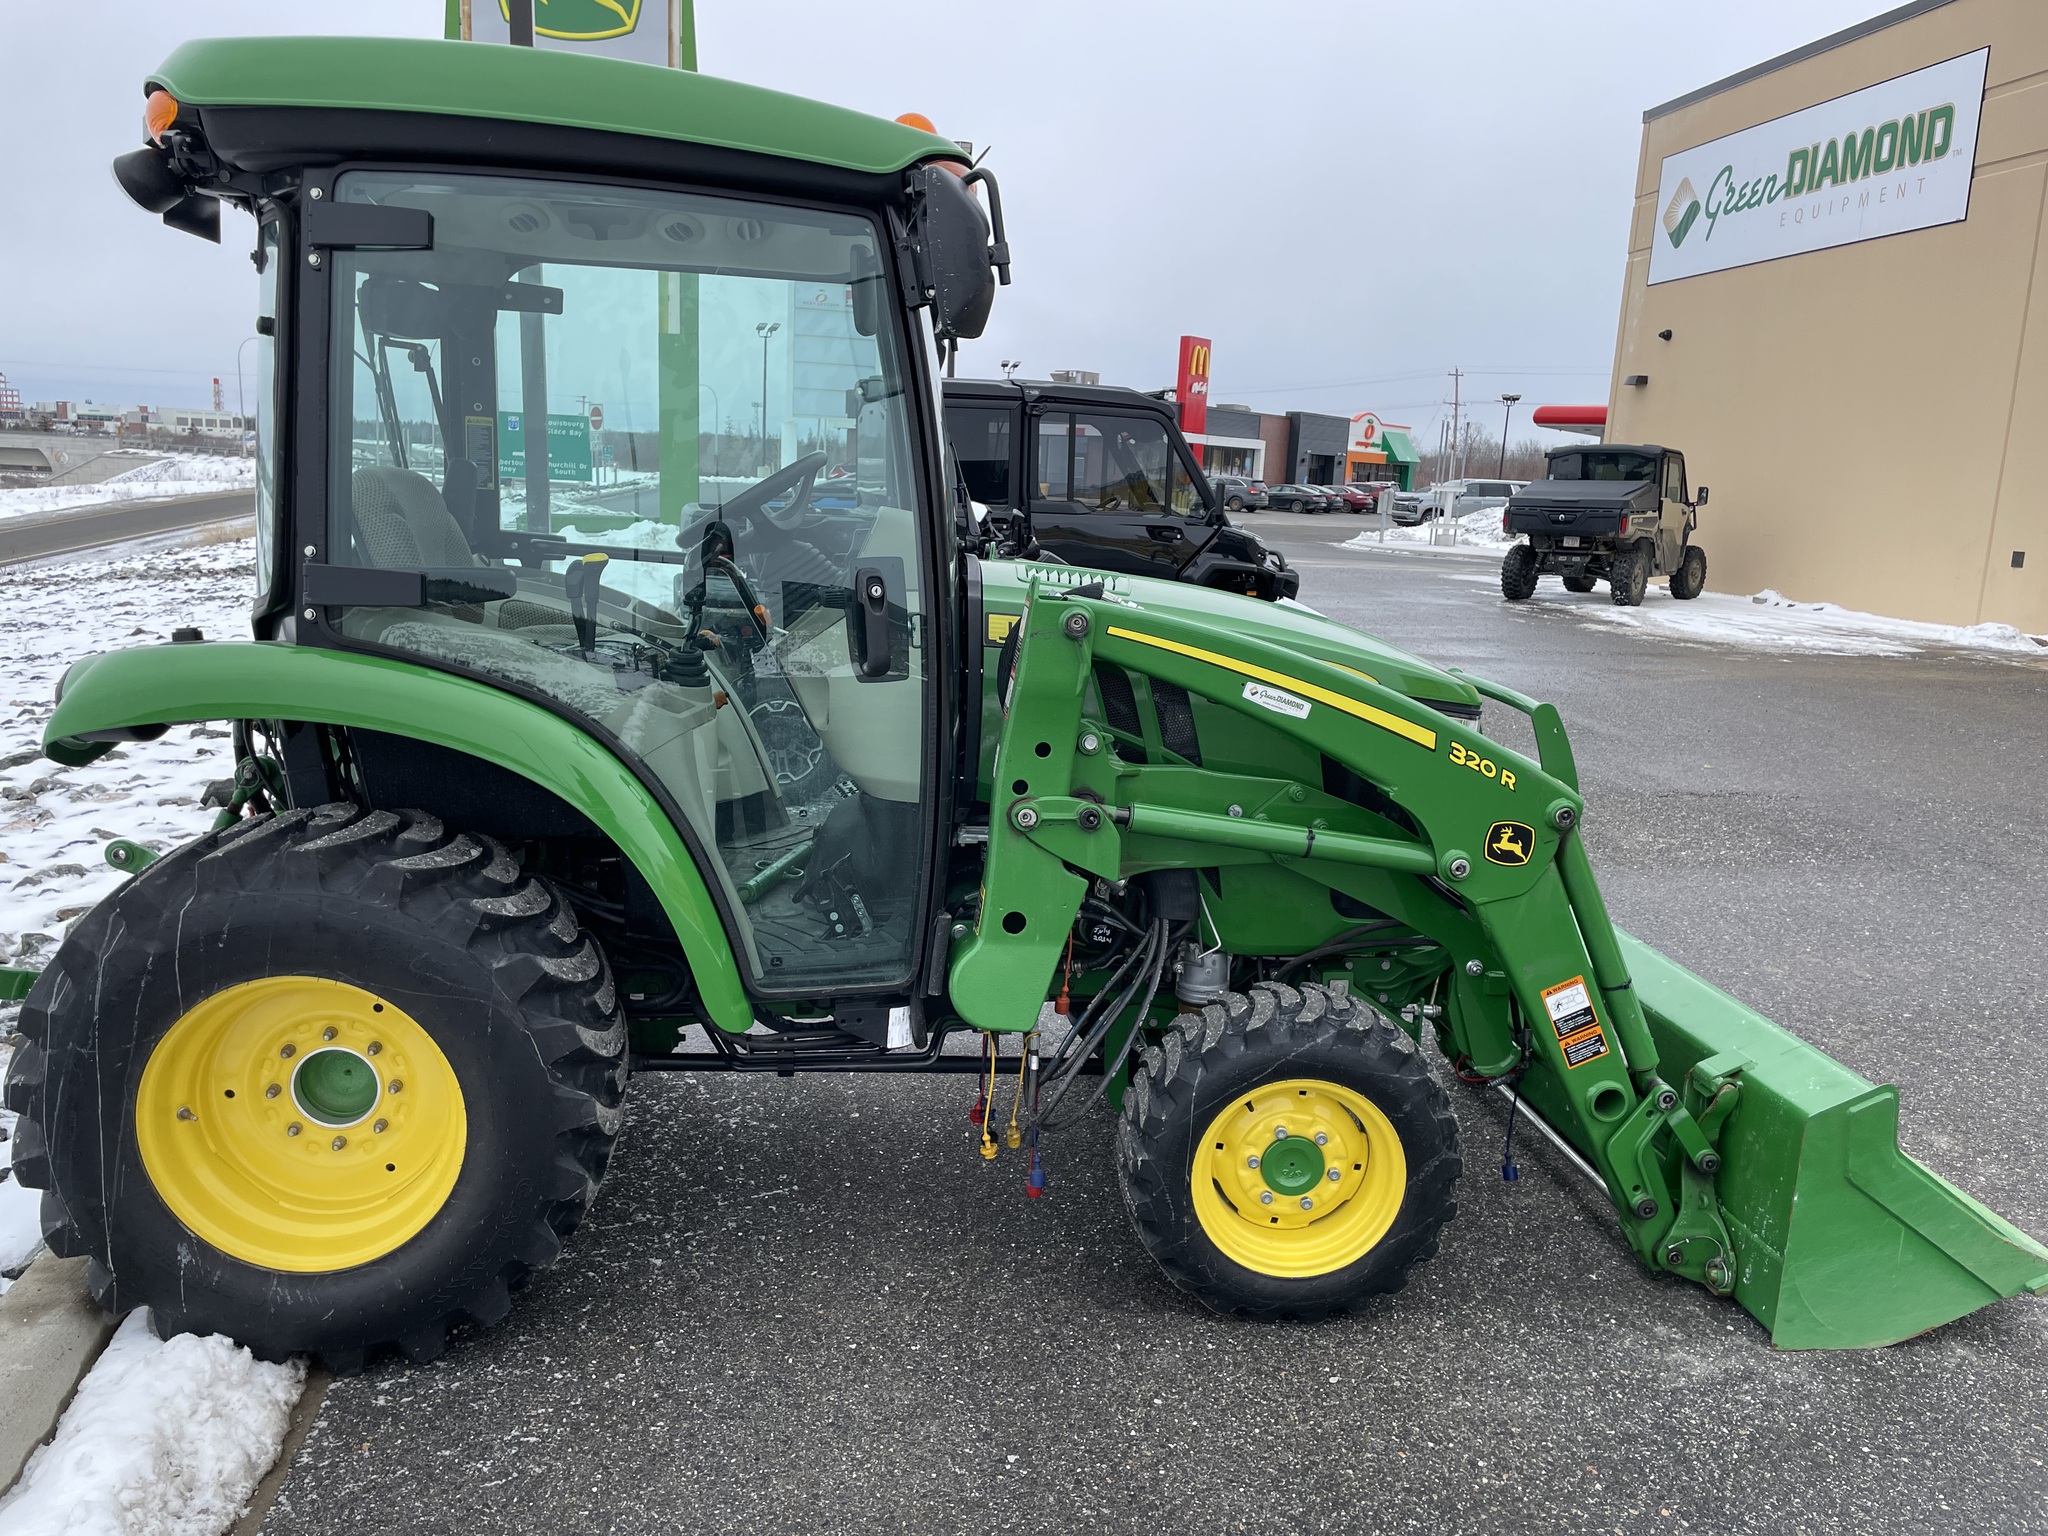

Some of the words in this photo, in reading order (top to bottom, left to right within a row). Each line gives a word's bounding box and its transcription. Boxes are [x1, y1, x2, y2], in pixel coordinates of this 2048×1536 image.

[1779, 177, 1927, 227] EQUIPMENT
[547, 419, 585, 429] ouisbourg
[569, 429, 582, 438] Bay
[548, 461, 576, 469] hurchill
[554, 468, 576, 476] South
[1448, 741, 1497, 778] 320
[1500, 768, 1517, 792] R
[1093, 927, 1111, 936] July
[1552, 978, 1579, 993] WARNING
[1571, 1029, 1598, 1043] WARNING
